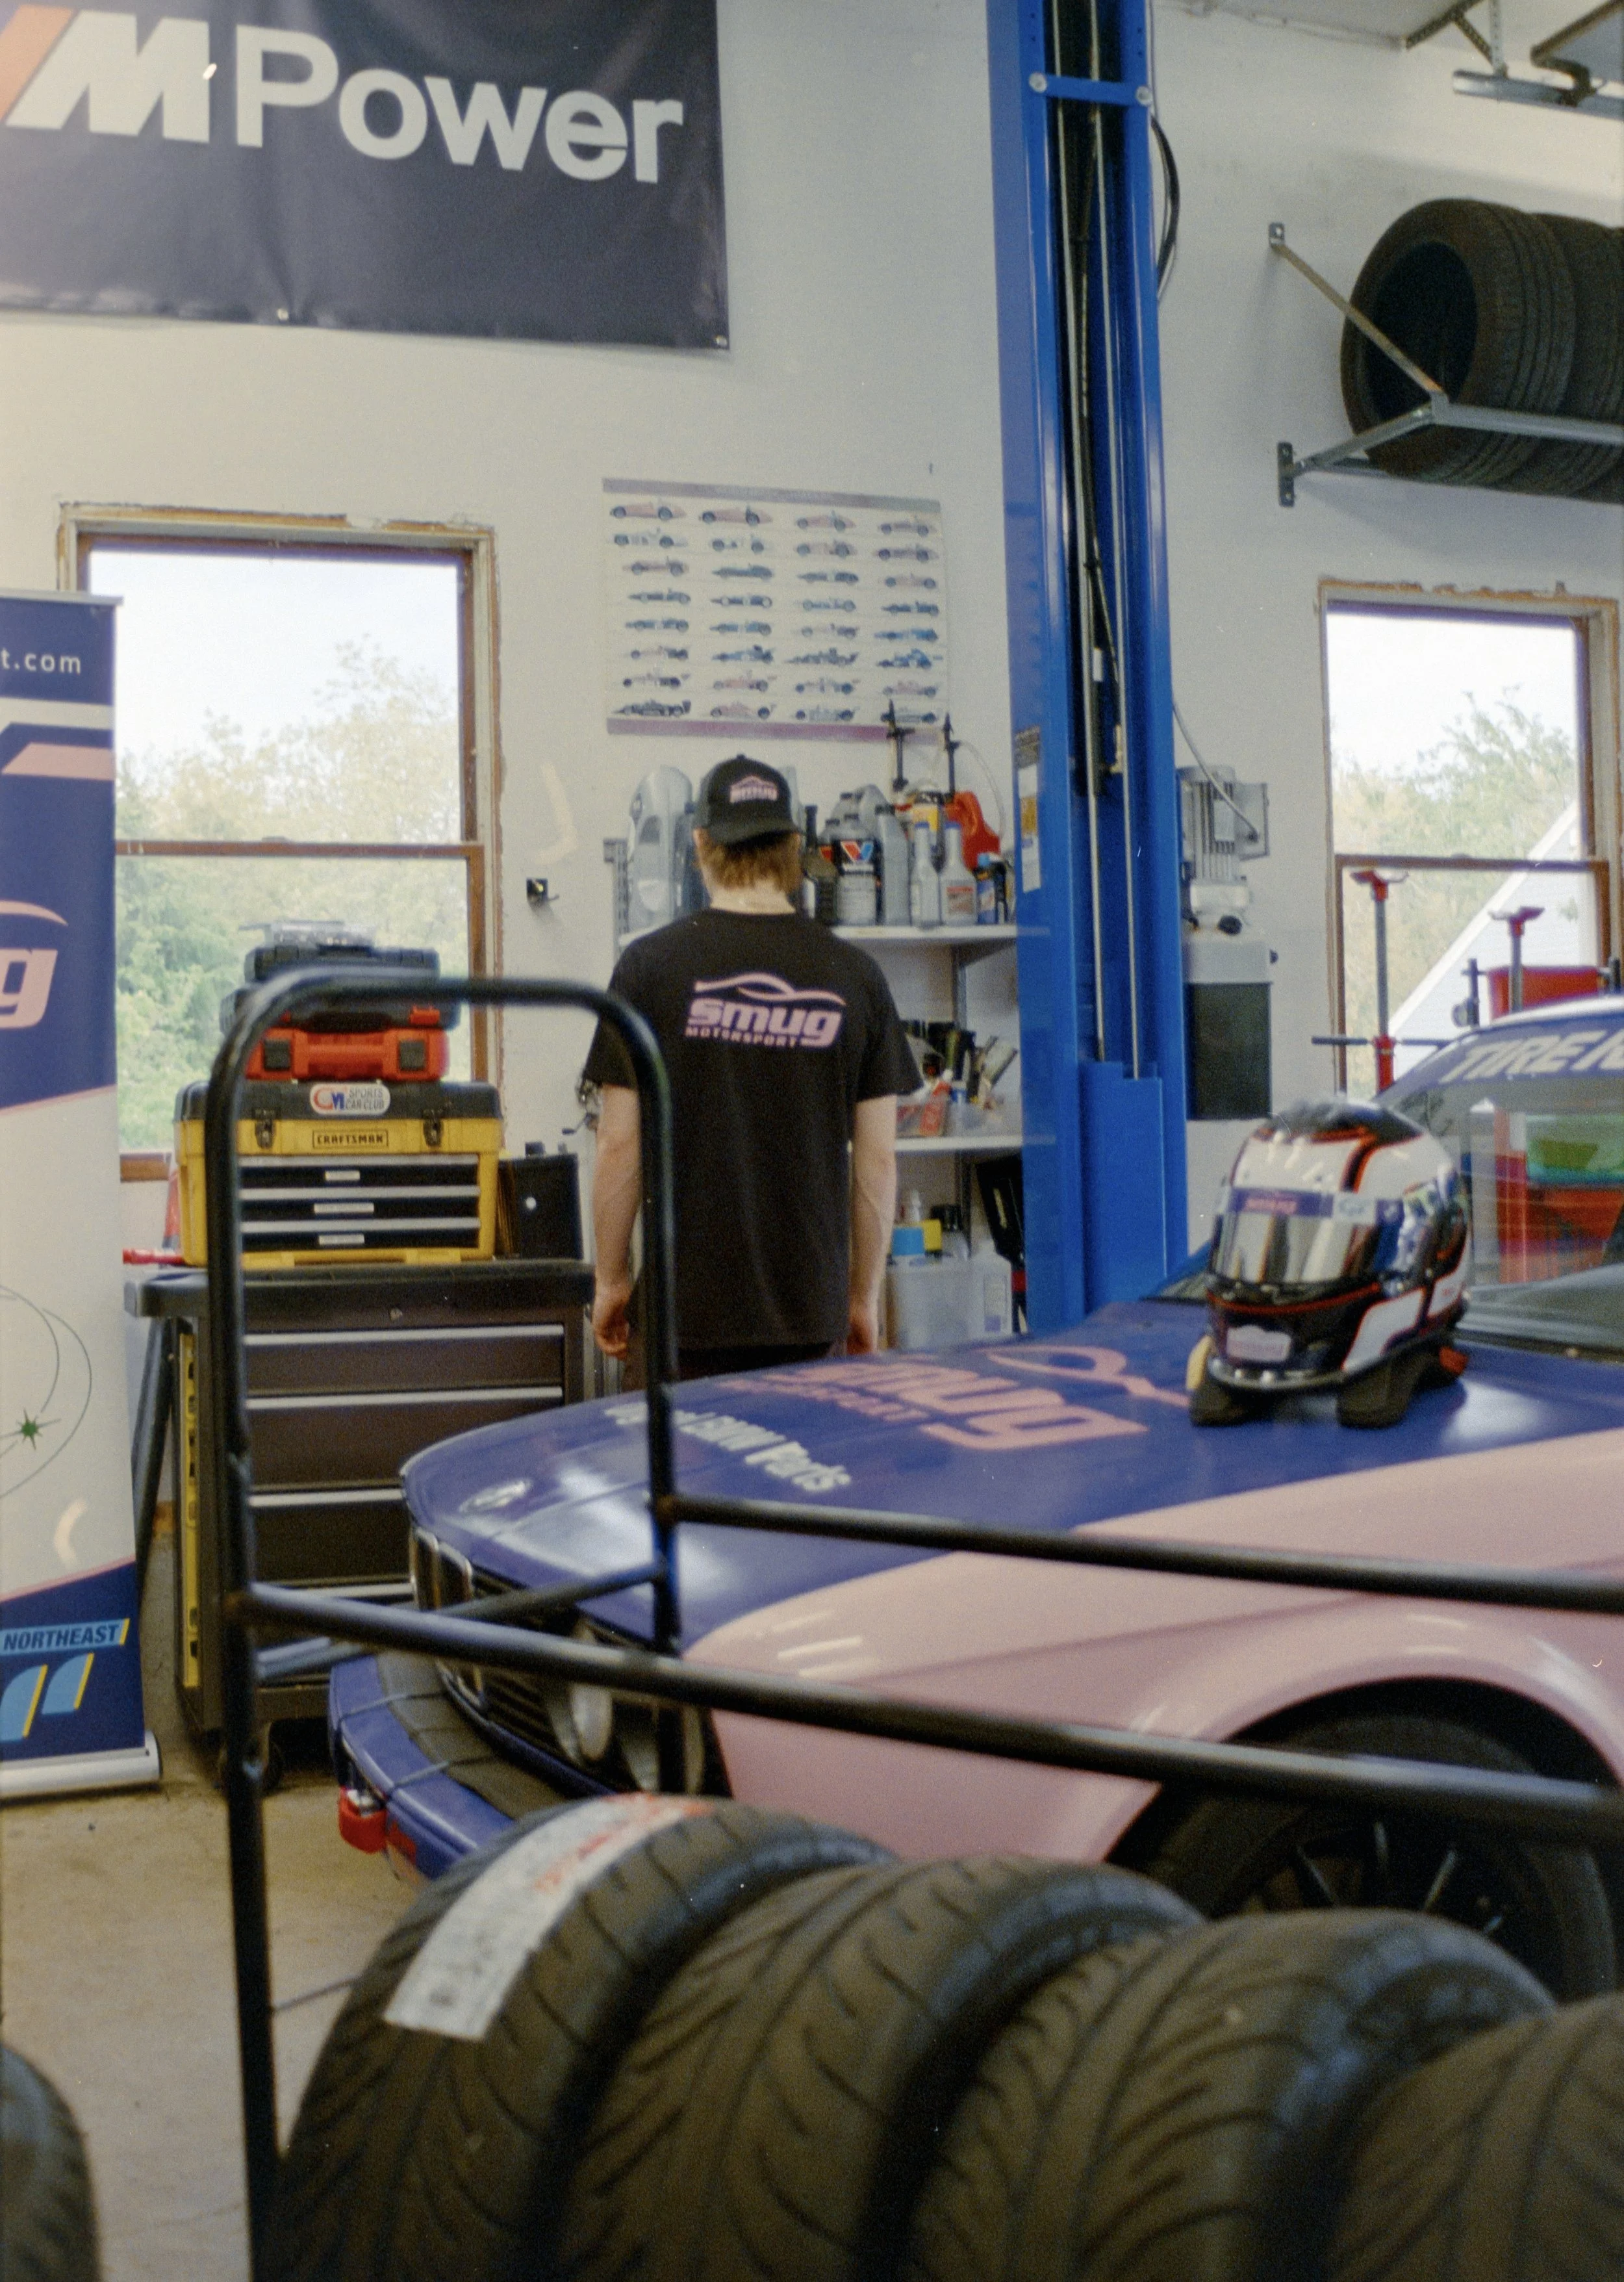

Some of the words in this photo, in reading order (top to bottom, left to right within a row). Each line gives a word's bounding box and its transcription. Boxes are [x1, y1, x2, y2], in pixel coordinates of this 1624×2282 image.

[236, 24, 683, 184] Power
[687, 997, 843, 1048] smug
[684, 1025, 798, 1048] MOTORSPORT
[349, 1086, 383, 1098] SPORTS
[345, 1098, 362, 1110] CAR
[364, 1098, 385, 1111] CLUB
[317, 1135, 383, 1144] CRAFTSMAN
[3, 1624, 120, 1651] NORTHEAST
